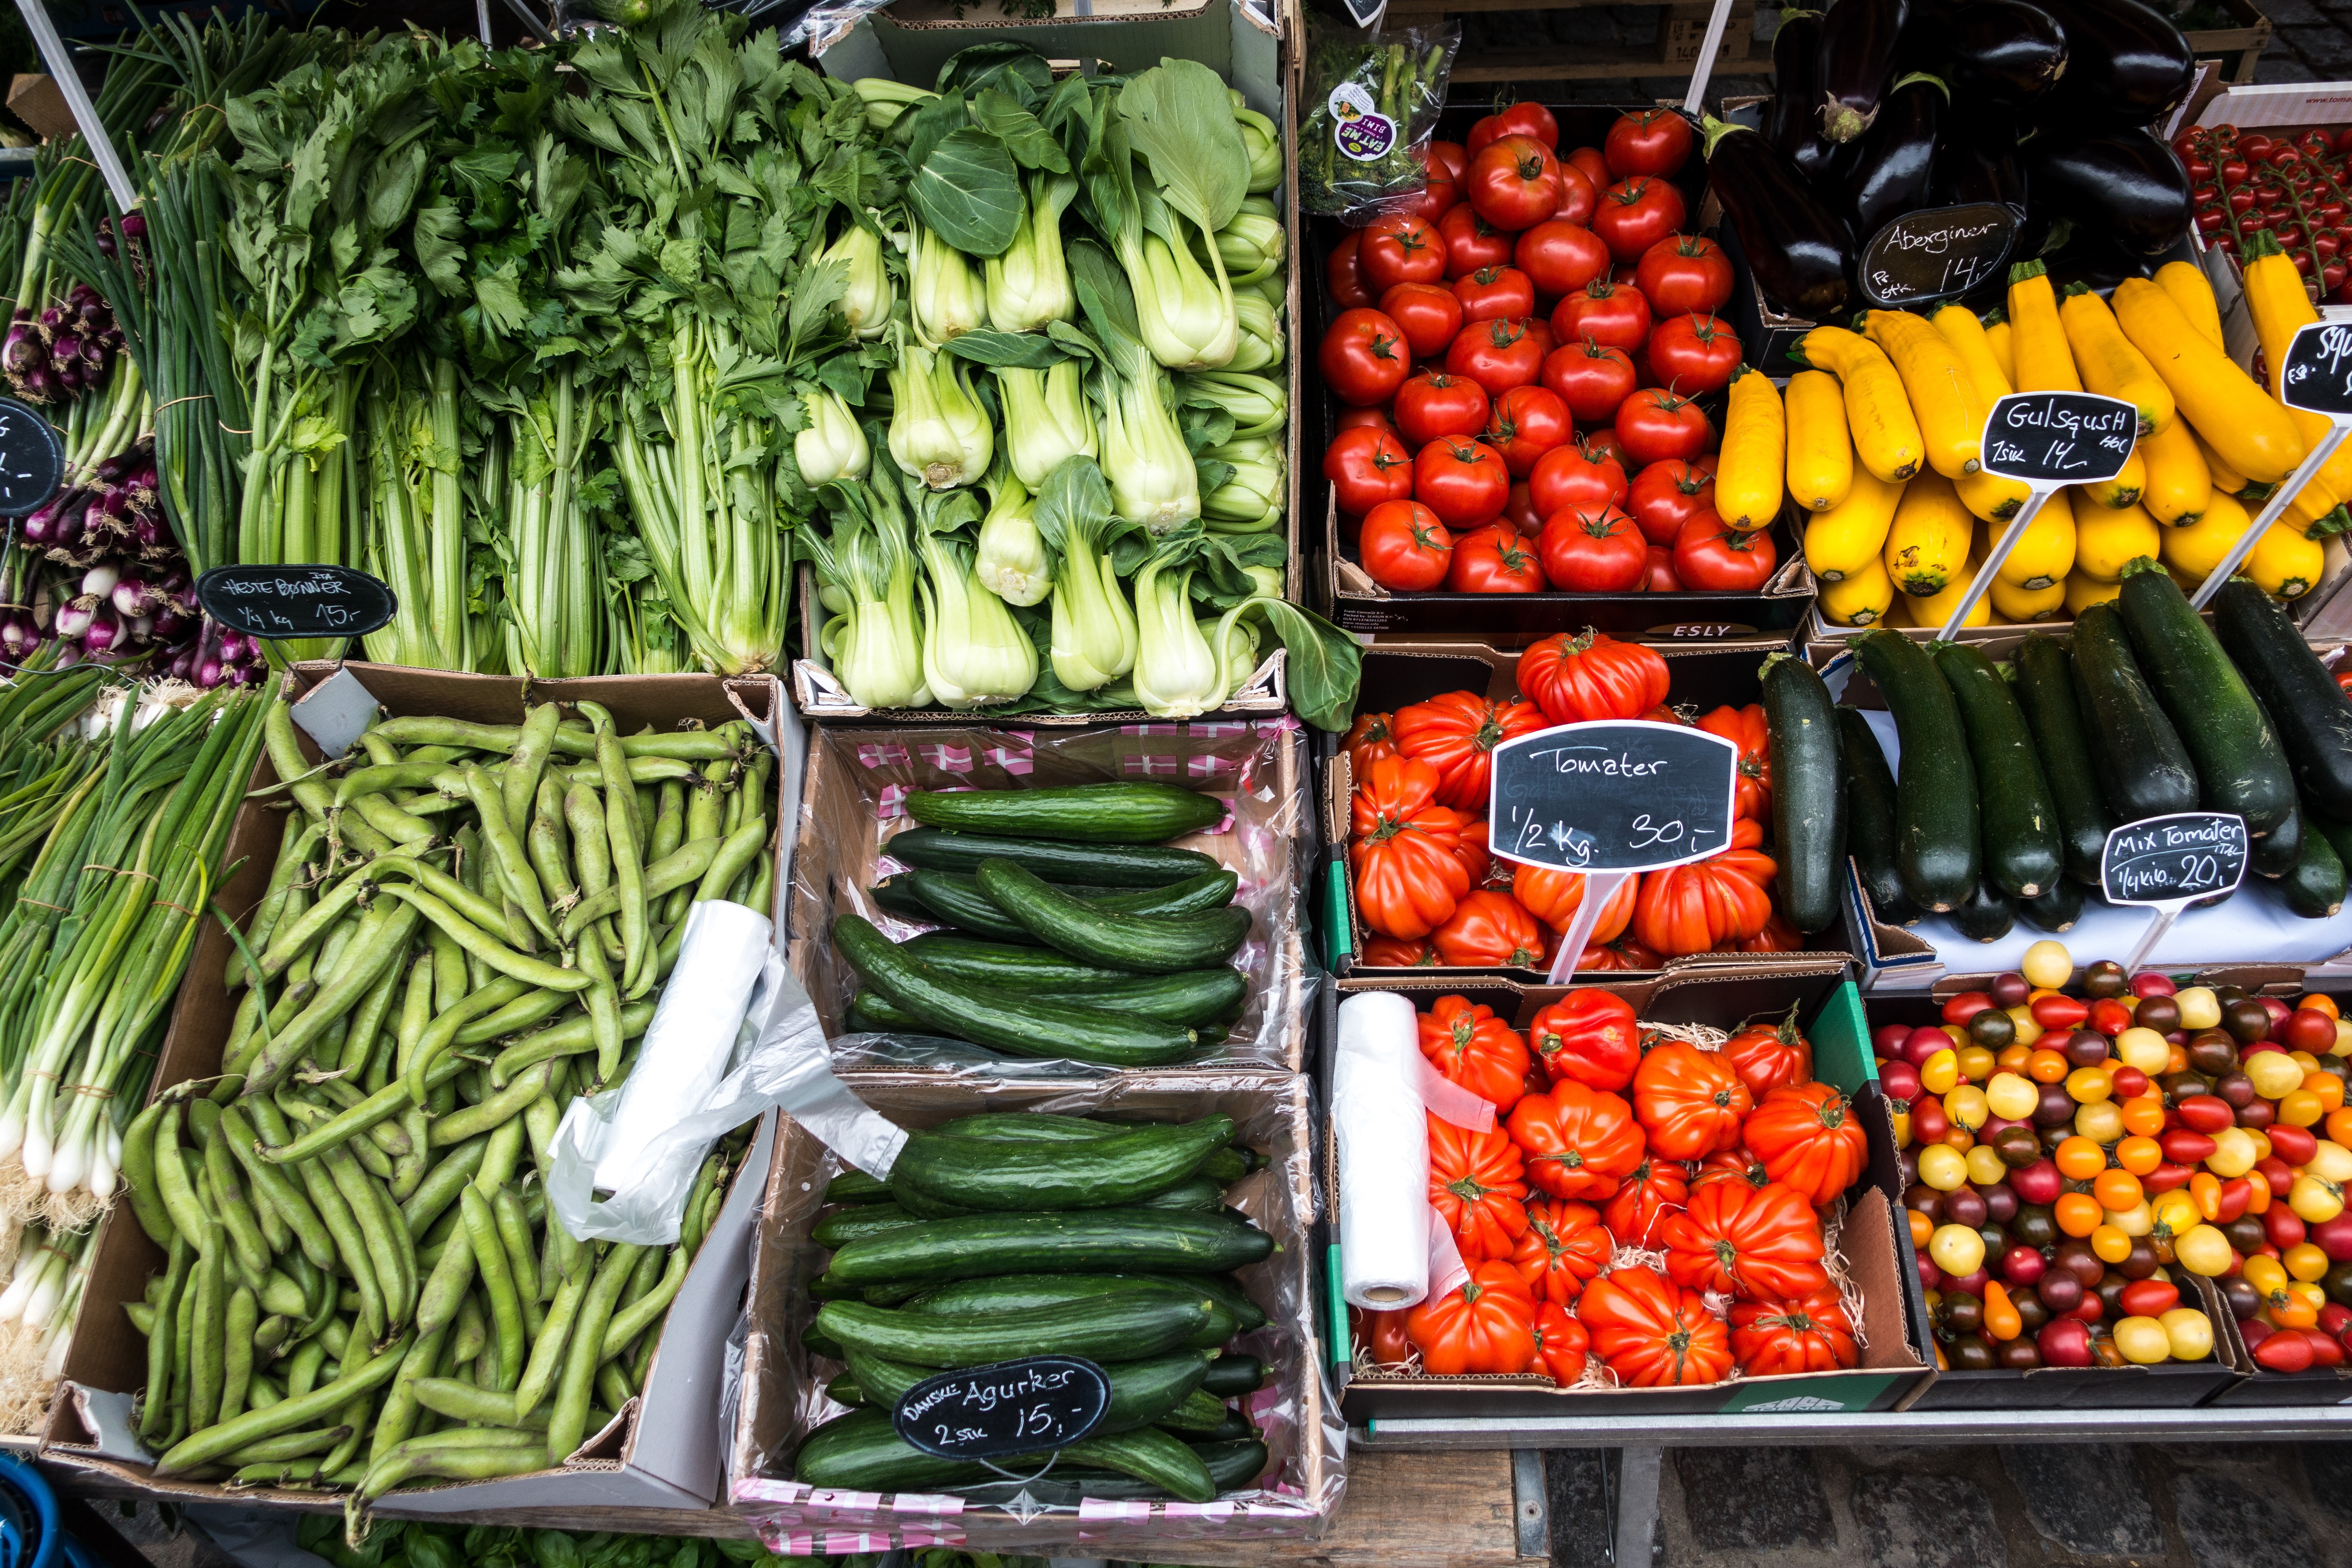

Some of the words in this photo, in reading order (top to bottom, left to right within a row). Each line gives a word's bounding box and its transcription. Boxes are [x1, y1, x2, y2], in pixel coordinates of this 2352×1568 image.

[1341, 127, 1362, 141] ME
[1361, 118, 1387, 133] BIMI
[1359, 135, 1386, 152] EAT
[1673, 624, 1732, 637] ESLY
[1529, 746, 1668, 777] Tomater
[2162, 818, 2242, 846] Tomater
[963, 1369, 1075, 1411] Agurker
